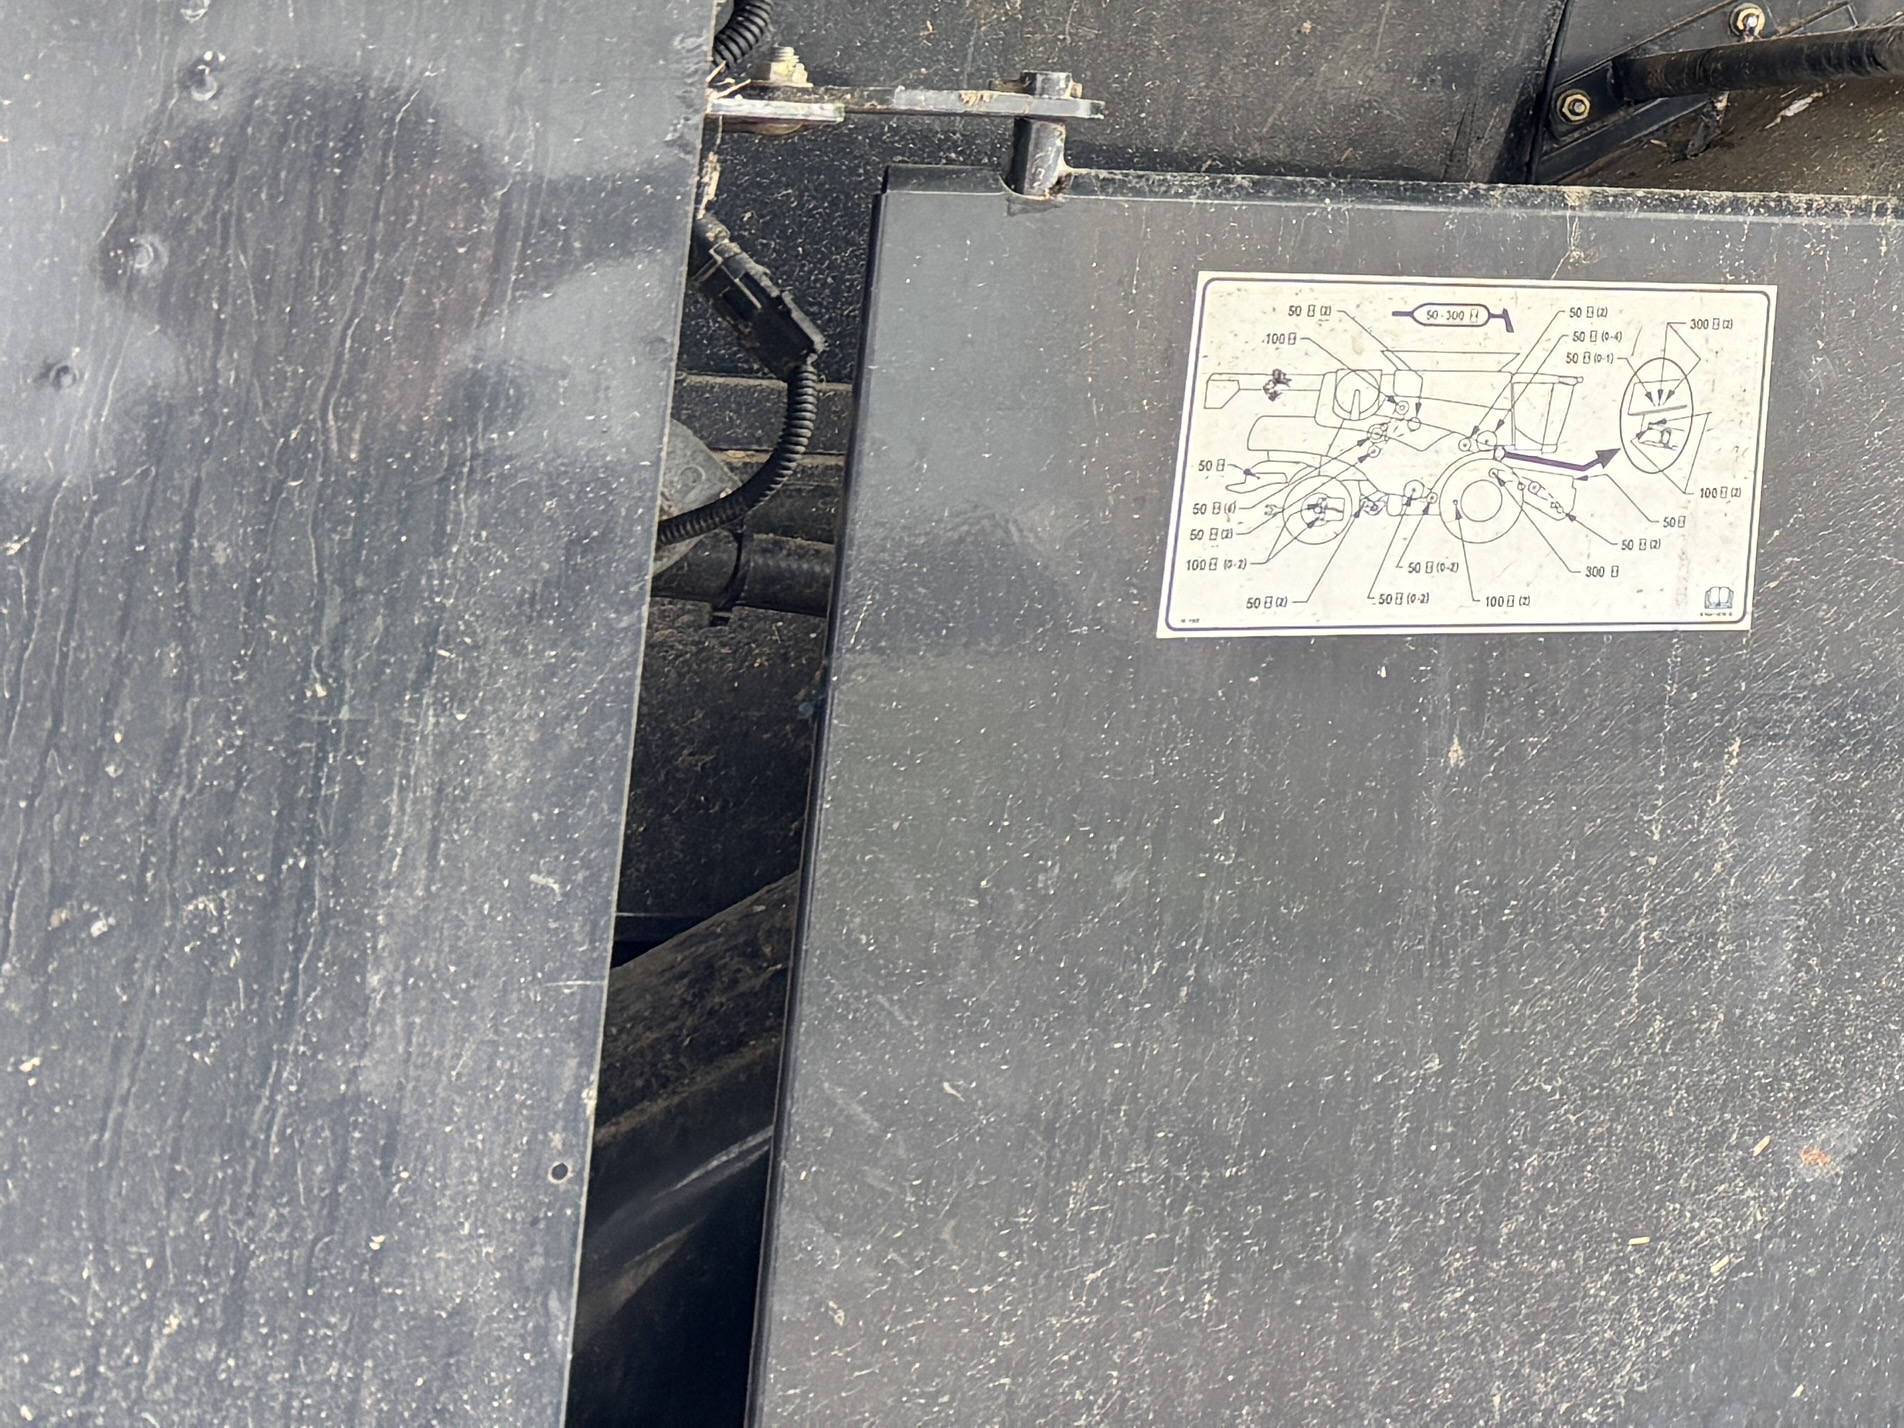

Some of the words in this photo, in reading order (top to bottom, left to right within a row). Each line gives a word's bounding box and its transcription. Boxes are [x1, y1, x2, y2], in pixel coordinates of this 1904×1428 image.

[1288, 305, 1302, 317] 50
[1569, 307, 1582, 318] 50
[1596, 306, 1608, 318] (2)
[1690, 319, 1709, 330] 300
[1722, 319, 1733, 329] (2)
[1266, 333, 1285, 344] 100
[1572, 331, 1585, 342] 50
[1566, 353, 1579, 364] 50
[1198, 460, 1213, 472] 50
[1700, 487, 1718, 498] 100
[1730, 487, 1742, 498] (2)
[1192, 503, 1207, 515] 50
[1663, 517, 1676, 528] 50
[1189, 529, 1204, 540] 50
[1221, 528, 1233, 540] (2)
[1621, 539, 1634, 550] 50
[1649, 539, 1661, 550] (2)
[1186, 559, 1206, 571] 100
[1408, 562, 1421, 574] 50
[1585, 566, 1605, 578] 300
[1246, 597, 1261, 609] 50
[1275, 596, 1288, 608] (2)
[1378, 593, 1392, 605] 50
[1485, 596, 1504, 607] 100
[1518, 595, 1530, 606] (2)
